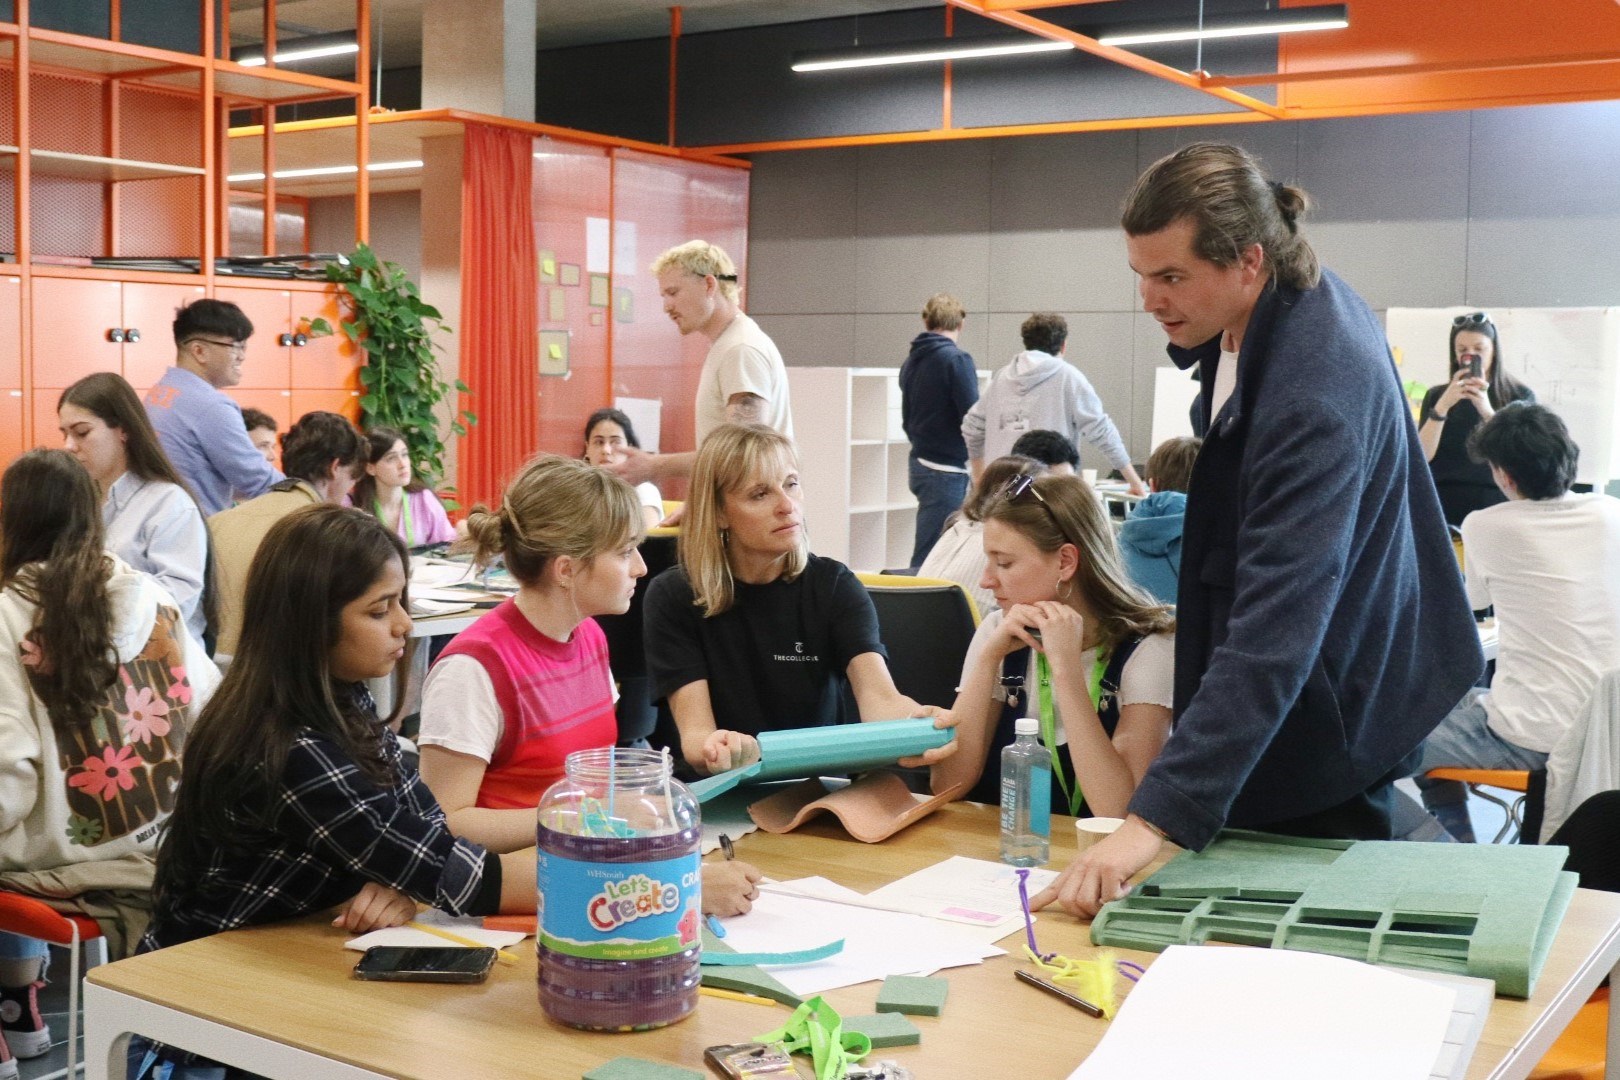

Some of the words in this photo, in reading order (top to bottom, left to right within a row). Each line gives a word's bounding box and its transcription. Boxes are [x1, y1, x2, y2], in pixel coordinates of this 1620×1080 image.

[1007, 788, 1016, 830] CHANGE
[586, 869, 624, 879] WHSmith
[607, 878, 649, 899] Let's
[590, 883, 678, 929] Create
